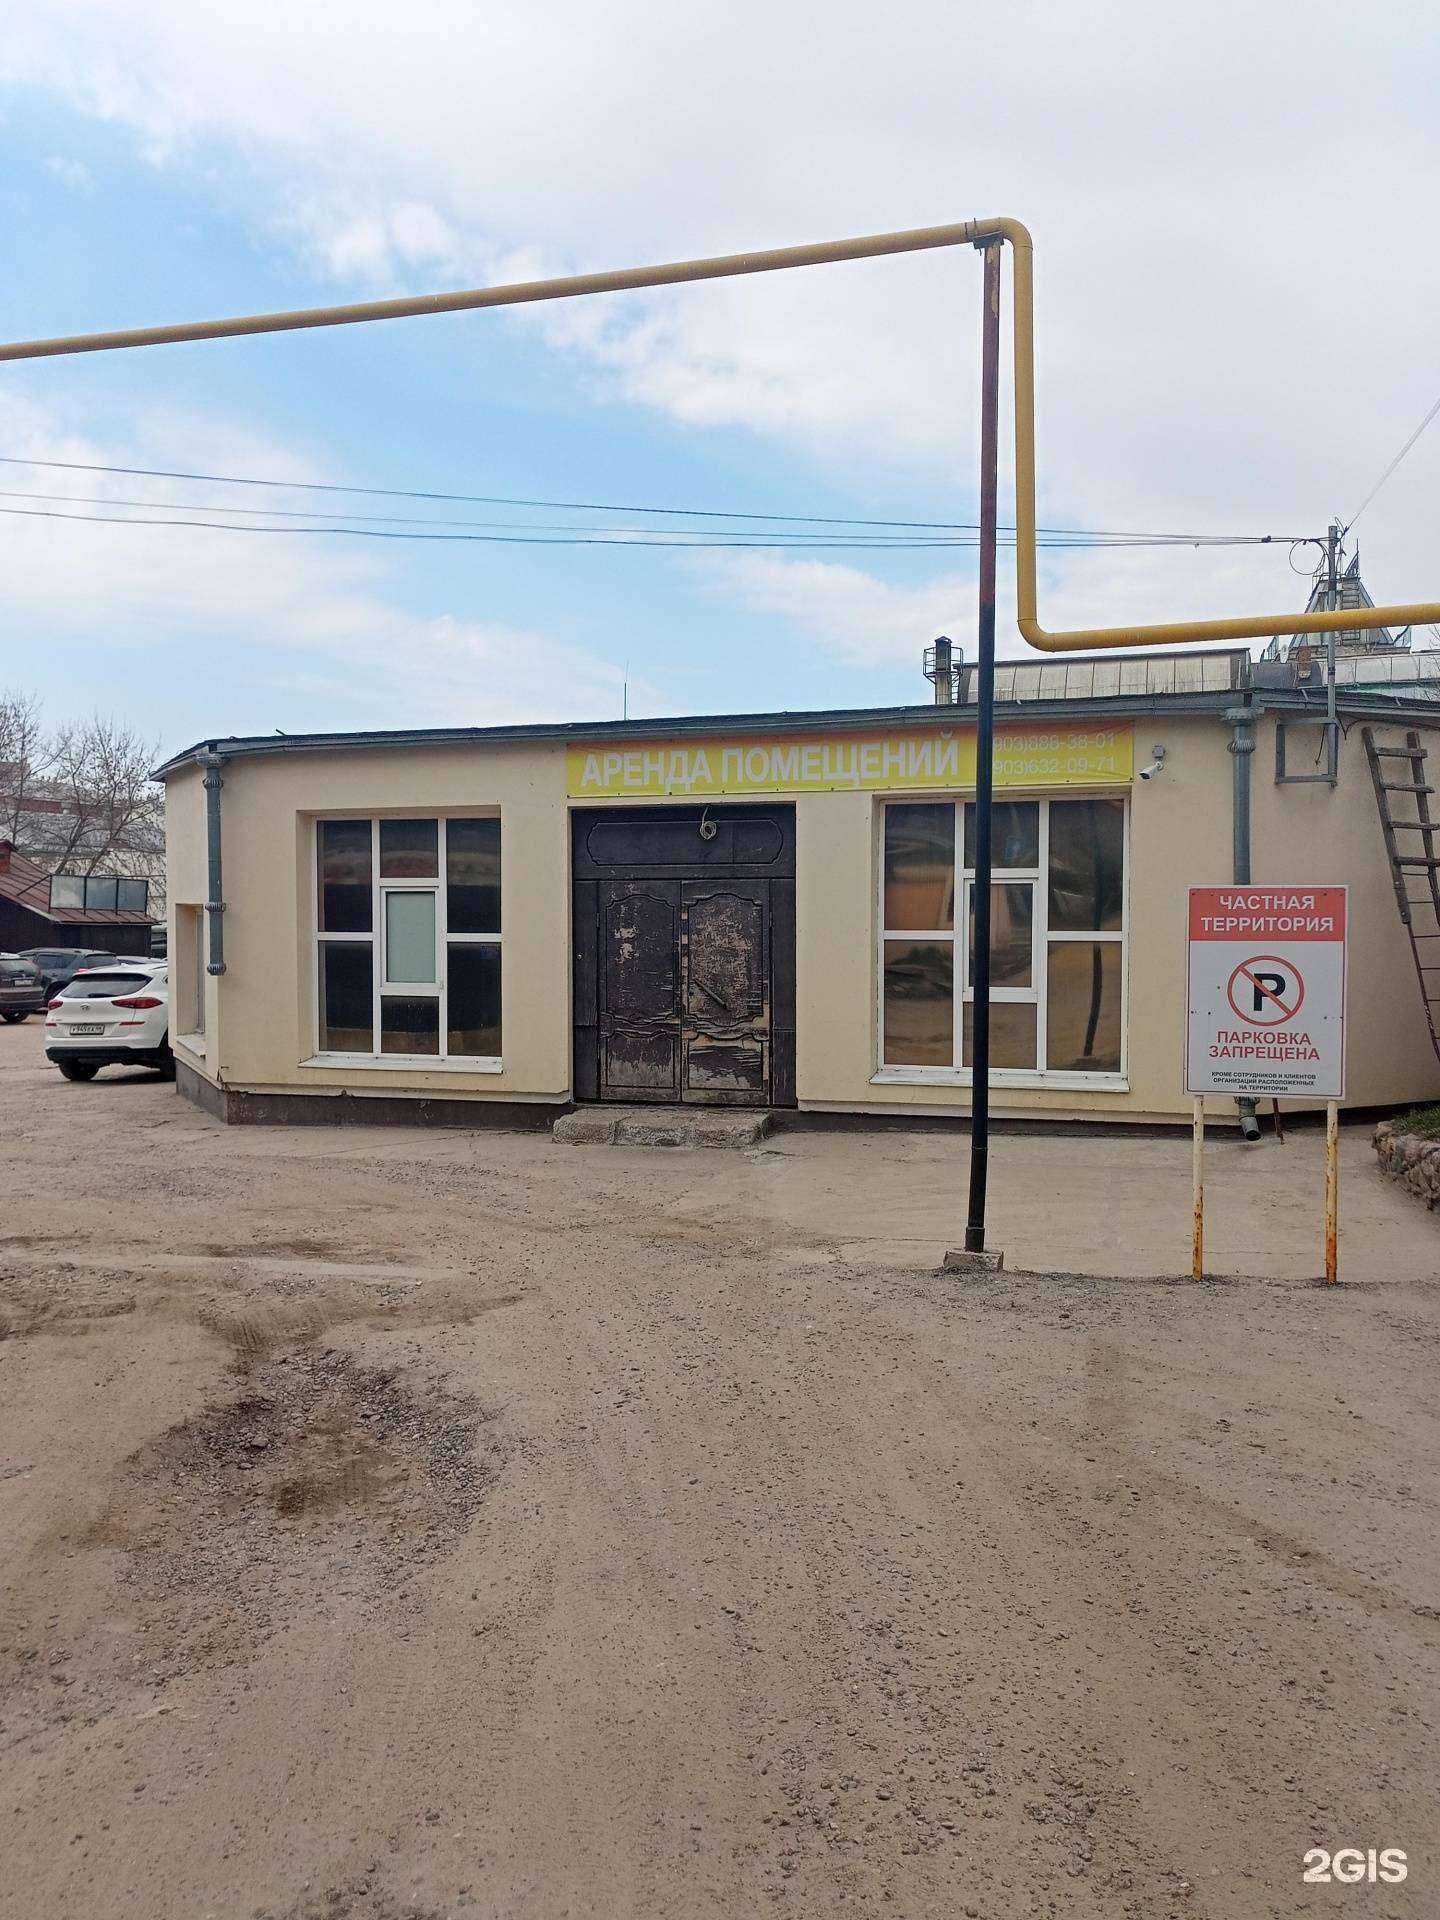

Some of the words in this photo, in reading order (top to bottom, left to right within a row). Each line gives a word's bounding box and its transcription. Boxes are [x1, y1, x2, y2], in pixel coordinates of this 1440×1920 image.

[581, 747, 714, 791] АРЕНДА
[721, 730, 960, 790] ПОМЕЩЕНИЙ
[1219, 895, 1316, 910] ЧАСТНАЯ
[1200, 916, 1334, 932] ТЕРРИТОРИЯ
[1217, 1031, 1312, 1045] ПАРКОВКА
[1208, 1046, 1321, 1062] ЗАПРЕЩЕНА
